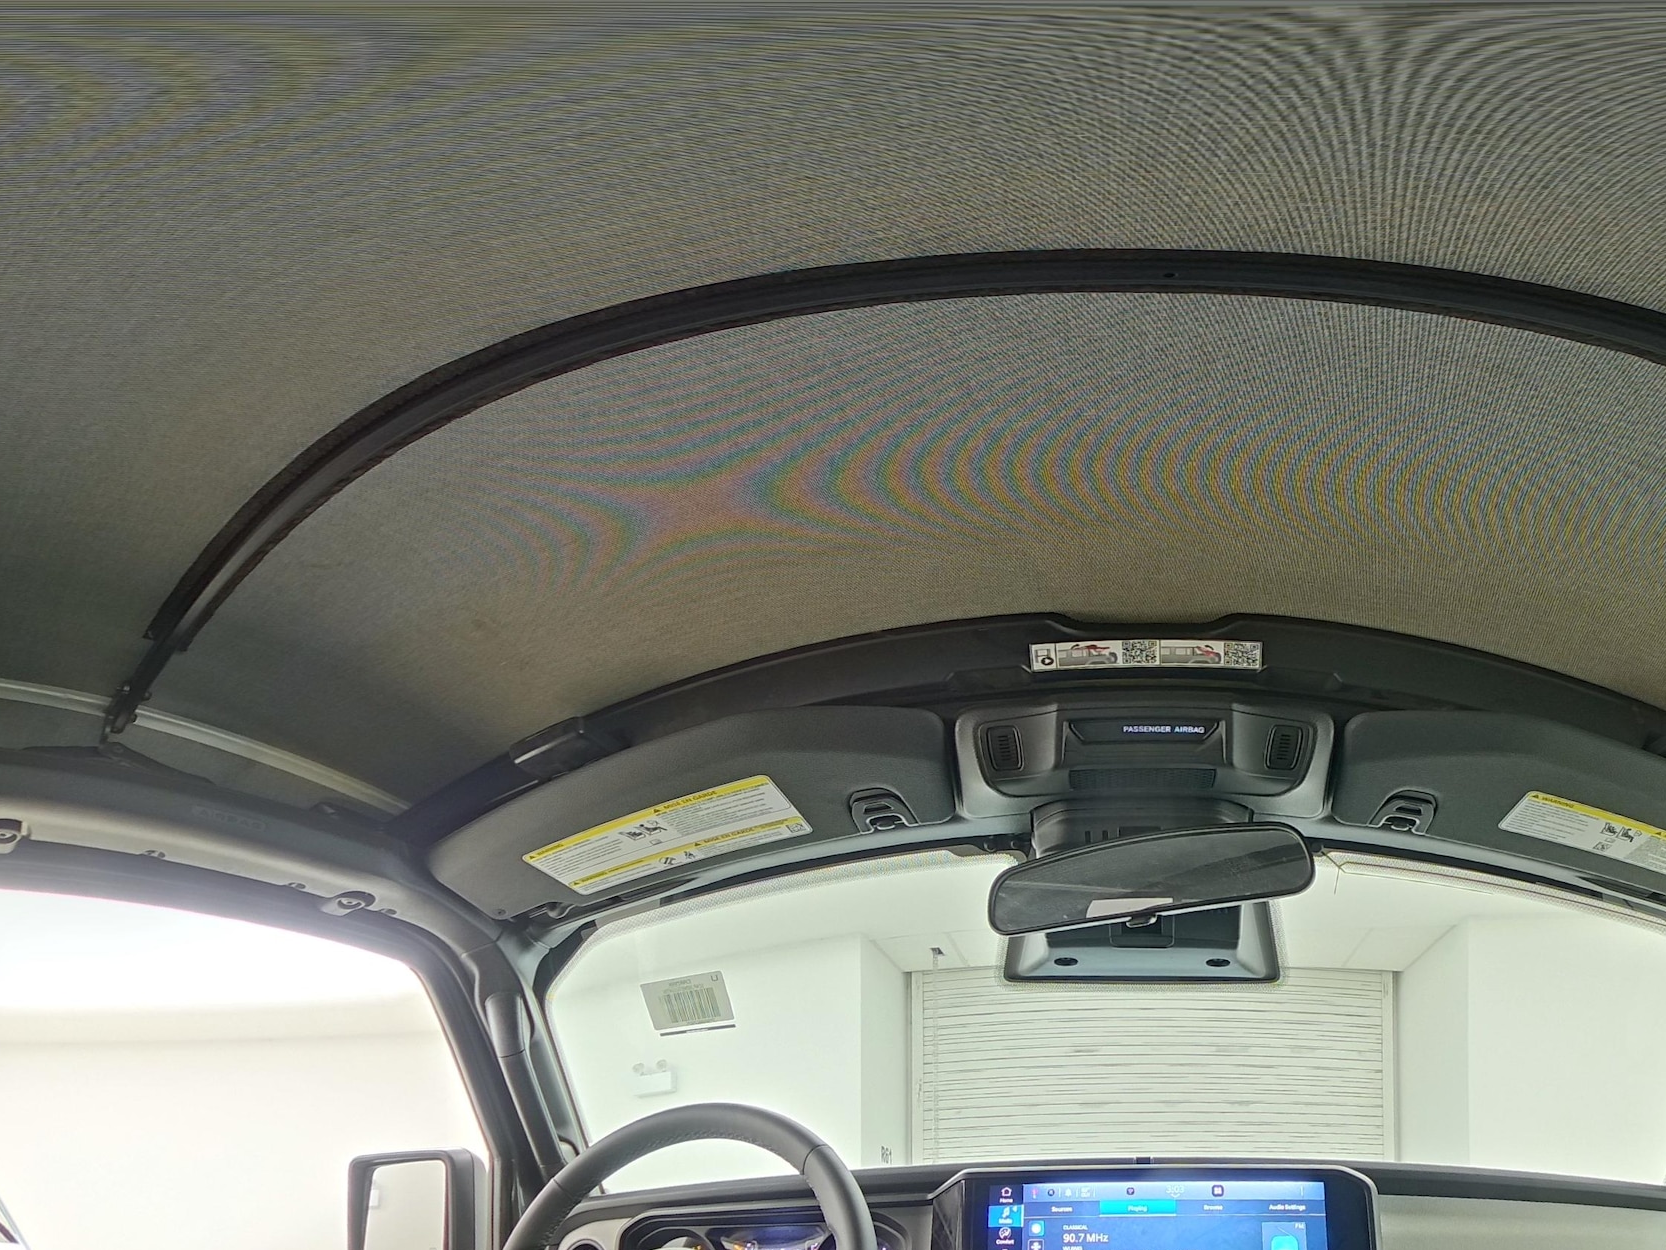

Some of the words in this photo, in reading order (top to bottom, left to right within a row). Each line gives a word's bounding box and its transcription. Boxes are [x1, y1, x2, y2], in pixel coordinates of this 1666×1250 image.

[1123, 725, 1171, 733] PASSENGER
[1174, 725, 1205, 734] AIRBAG
[1166, 1185, 1185, 1194] 3:03
[1062, 1233, 1085, 1243] 90.7
[1086, 1233, 1109, 1243] MHz
